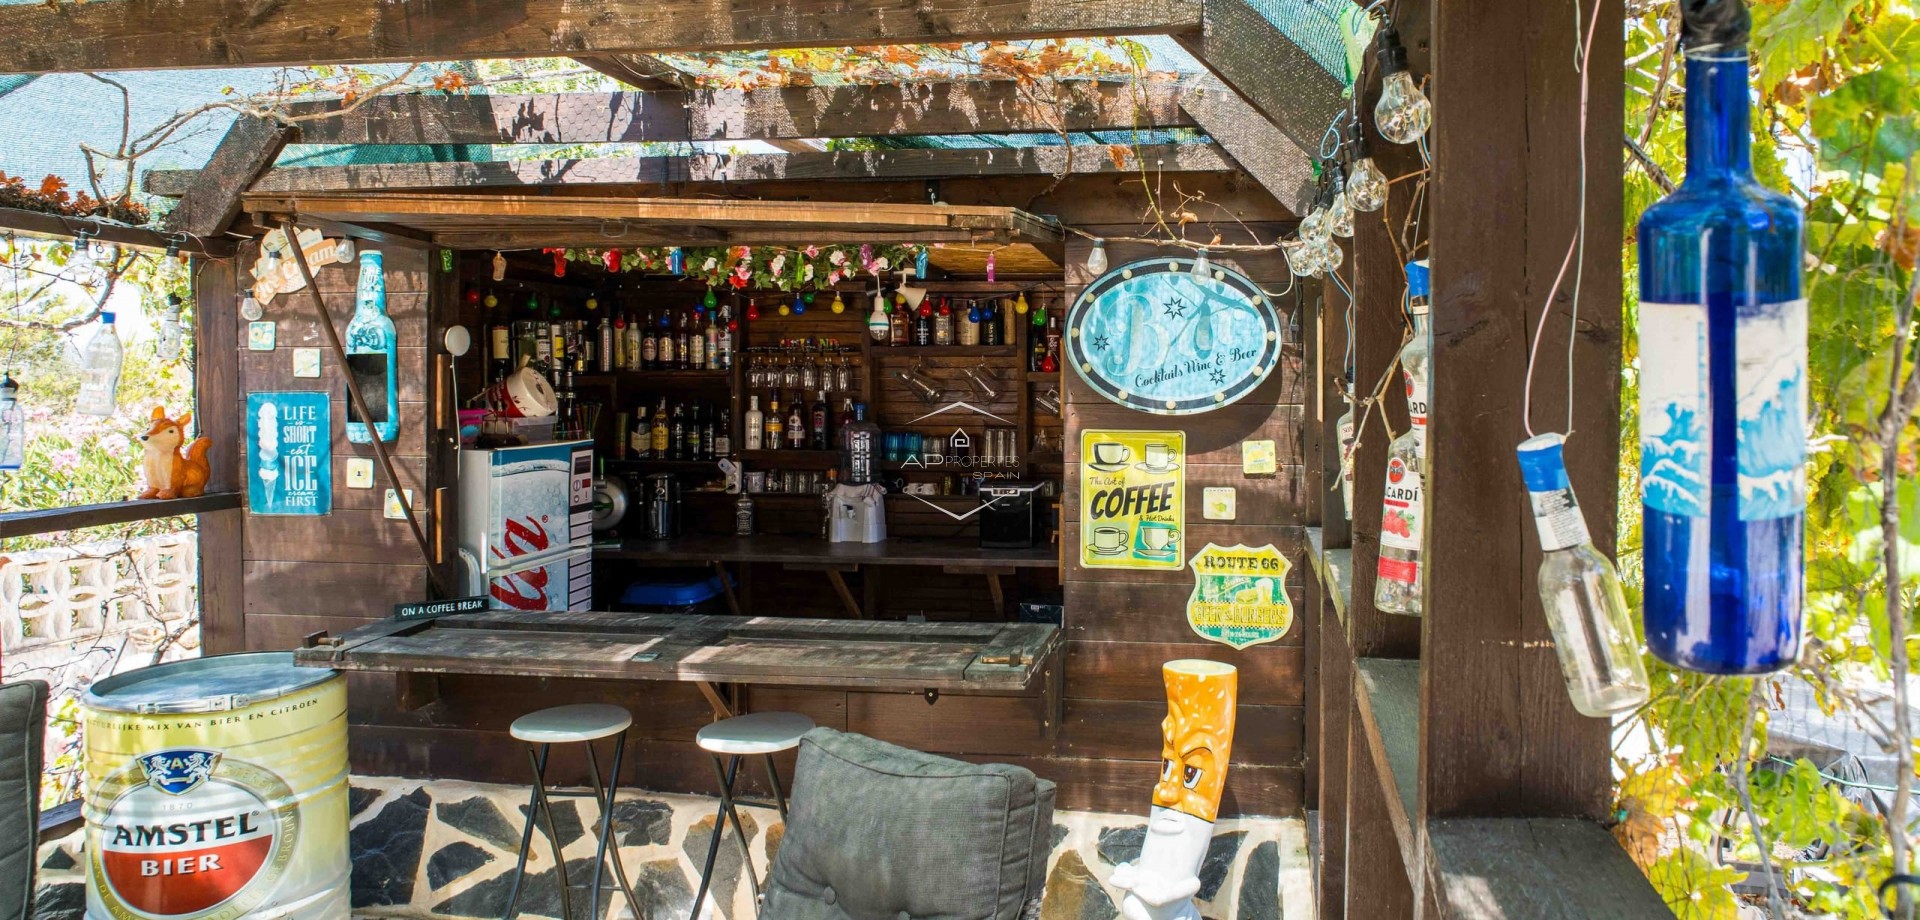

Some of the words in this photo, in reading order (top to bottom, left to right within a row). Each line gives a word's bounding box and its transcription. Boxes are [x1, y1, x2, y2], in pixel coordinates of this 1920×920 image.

[1134, 366, 1184, 389] Cocktails
[1184, 358, 1212, 377] Wine
[1215, 352, 1226, 366] &
[1230, 347, 1258, 363] Beer
[283, 406, 317, 420] LIFE
[283, 425, 317, 444] SHORT
[290, 443, 314, 456] eat
[284, 455, 318, 491] ICE
[1089, 476, 1102, 486] The
[1103, 477, 1117, 487] Art
[1118, 477, 1126, 489] of
[285, 496, 318, 507] FIRST
[1090, 481, 1175, 520] COFFEE
[1157, 515, 1175, 523] Drinks
[1203, 556, 1258, 570] ROUTE
[1261, 558, 1279, 571] 66
[401, 606, 416, 617] ON
[418, 605, 425, 615] A
[426, 602, 456, 615] COFFEE
[457, 600, 484, 611] BREAK
[1195, 605, 1224, 623] BEER
[1234, 606, 1286, 625] BURGERS
[147, 723, 170, 731] MIX
[176, 721, 203, 730] VAN
[210, 716, 241, 727] BIER
[249, 711, 264, 721] EN
[271, 698, 318, 716] CITROEN
[171, 758, 183, 770] A
[162, 802, 194, 811] 1870
[112, 812, 260, 847] AMSTEL
[141, 853, 223, 877] BIER
